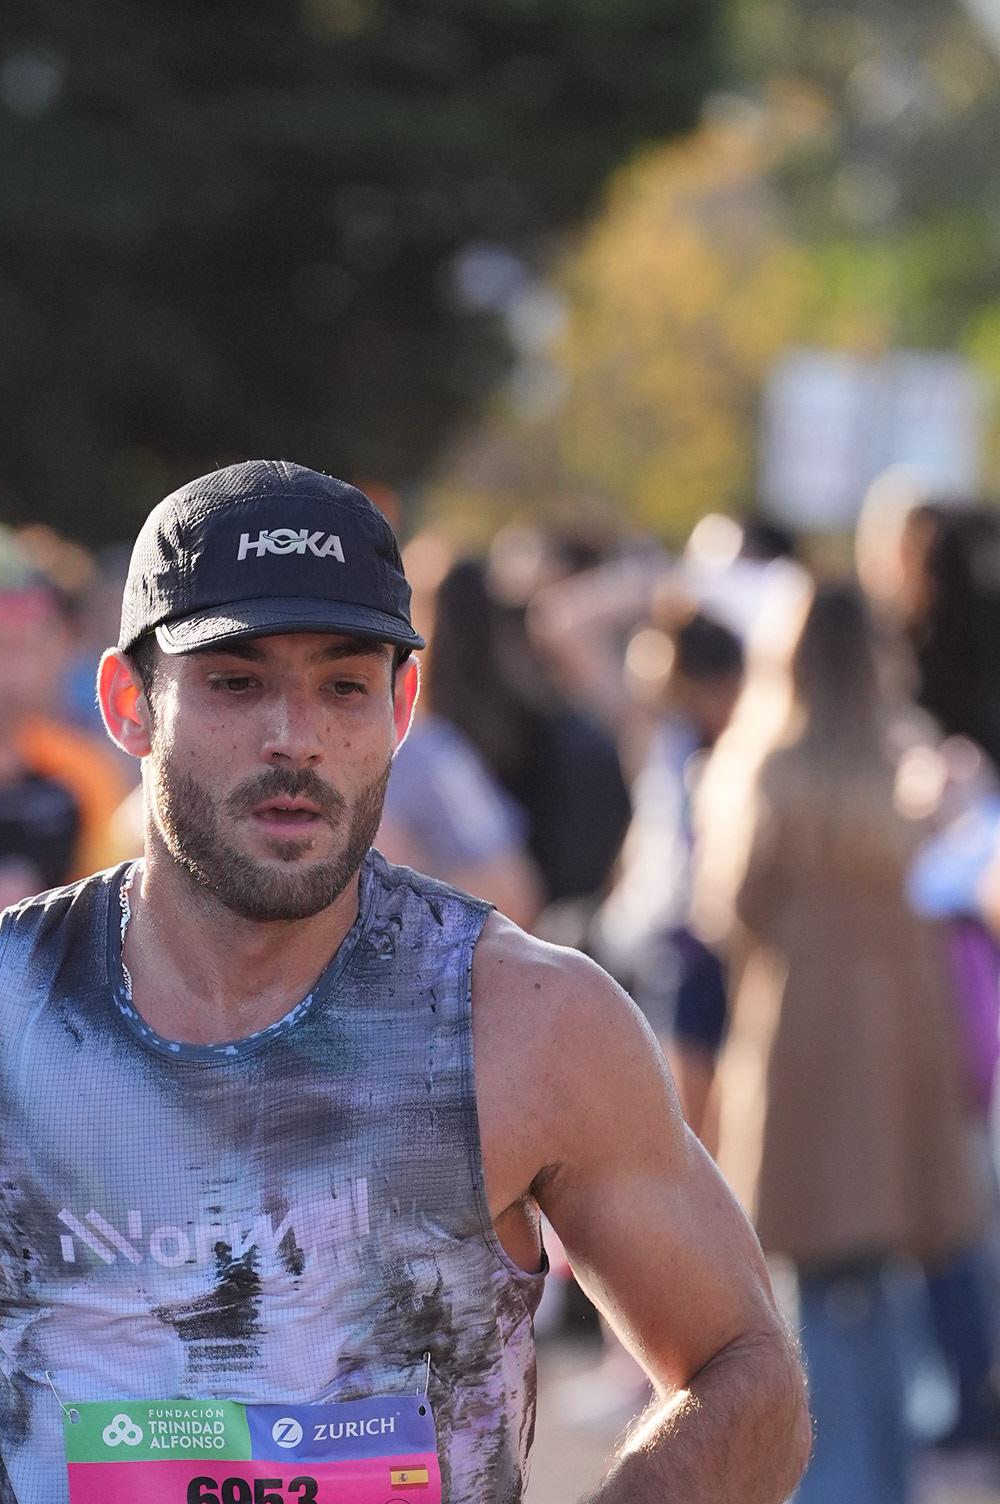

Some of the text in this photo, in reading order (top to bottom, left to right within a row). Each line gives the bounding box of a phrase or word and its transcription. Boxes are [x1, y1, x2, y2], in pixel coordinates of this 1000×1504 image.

[237, 528, 345, 563] HOKA
[149, 1408, 224, 1418] FUNDACIÓN
[148, 1421, 225, 1434] TRINIDAD
[313, 1417, 395, 1441] ZURICH
[150, 1436, 225, 1449] ALFONSO
